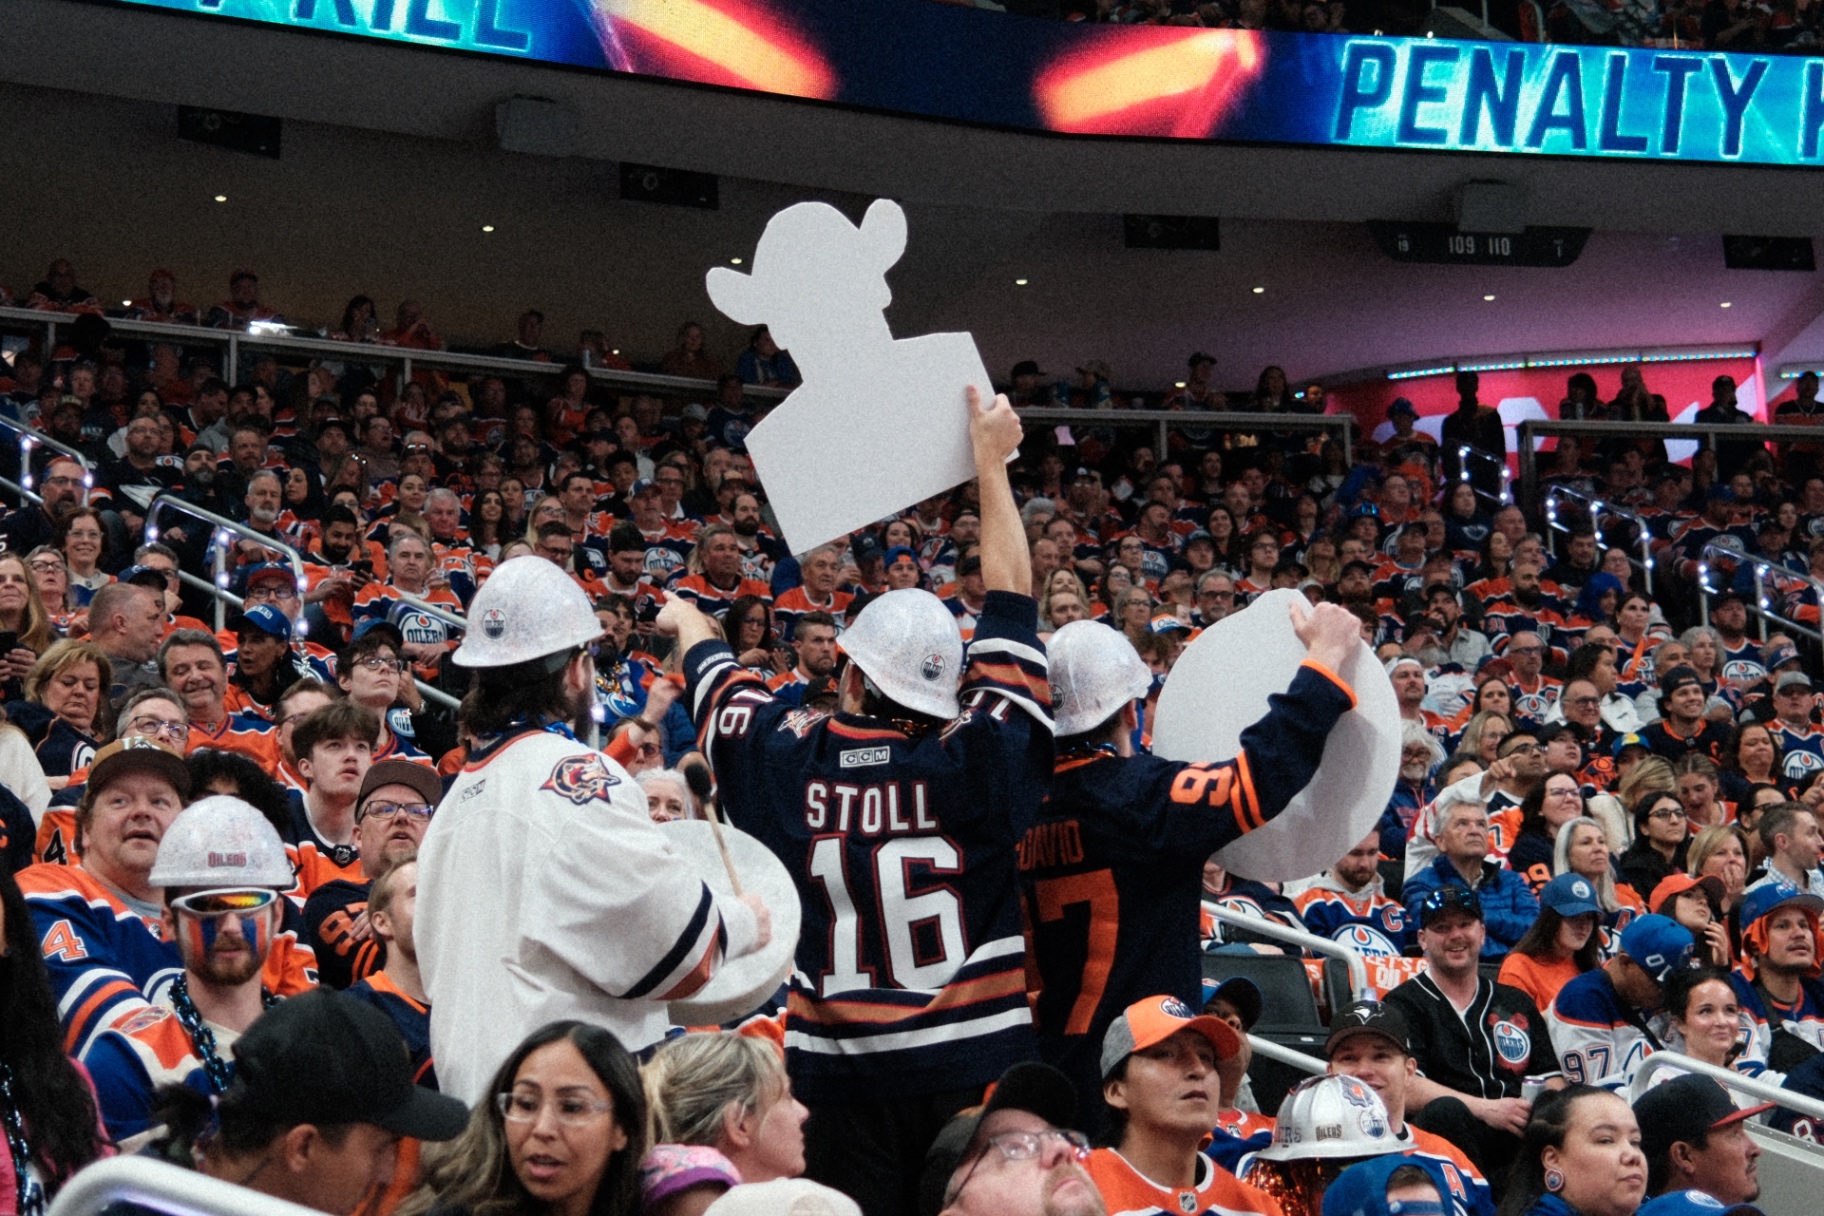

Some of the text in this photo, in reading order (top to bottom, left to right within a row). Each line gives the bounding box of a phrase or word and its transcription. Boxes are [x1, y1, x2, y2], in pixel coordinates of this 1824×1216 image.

[1334, 38, 1771, 160] PENALTY
[1449, 236, 1511, 256] 109 110
[843, 747, 889, 766] CCM
[805, 782, 938, 834] STOLL
[208, 853, 247, 868] OILERS
[807, 834, 968, 998] 16
[1382, 906, 1404, 932] C
[41, 919, 89, 962] 4
[1562, 1044, 1612, 1084] 97
[1316, 1124, 1342, 1140] OILERS
[1442, 1163, 1467, 1202] A
